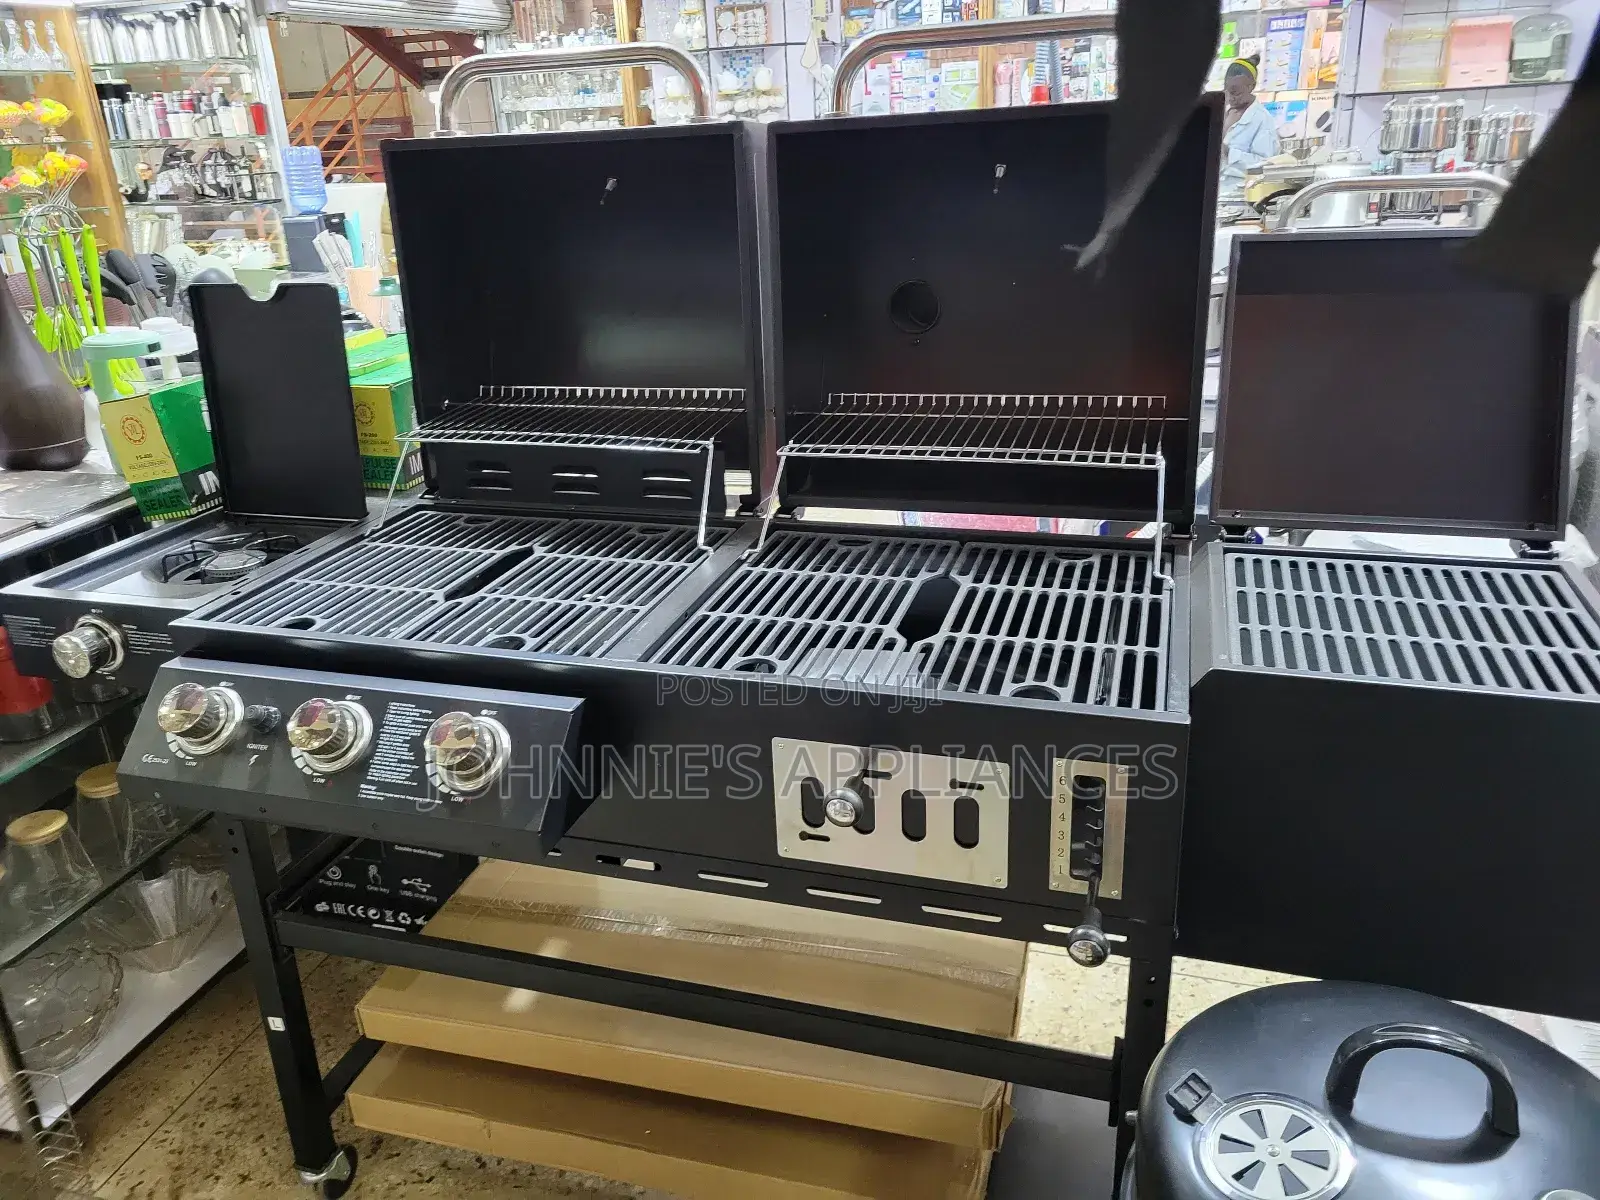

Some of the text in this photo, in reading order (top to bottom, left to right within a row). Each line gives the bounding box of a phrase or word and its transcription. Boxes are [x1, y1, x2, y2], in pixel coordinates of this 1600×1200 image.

[362, 457, 397, 470] PULSE
[246, 743, 269, 751] IGNITER
[1058, 776, 1067, 786] 6
[450, 795, 465, 803] LOW
[1058, 794, 1066, 804] 5
[1058, 812, 1066, 822] 4
[1057, 830, 1065, 840] 3
[1057, 847, 1065, 857] 2
[1058, 865, 1064, 875] 1
